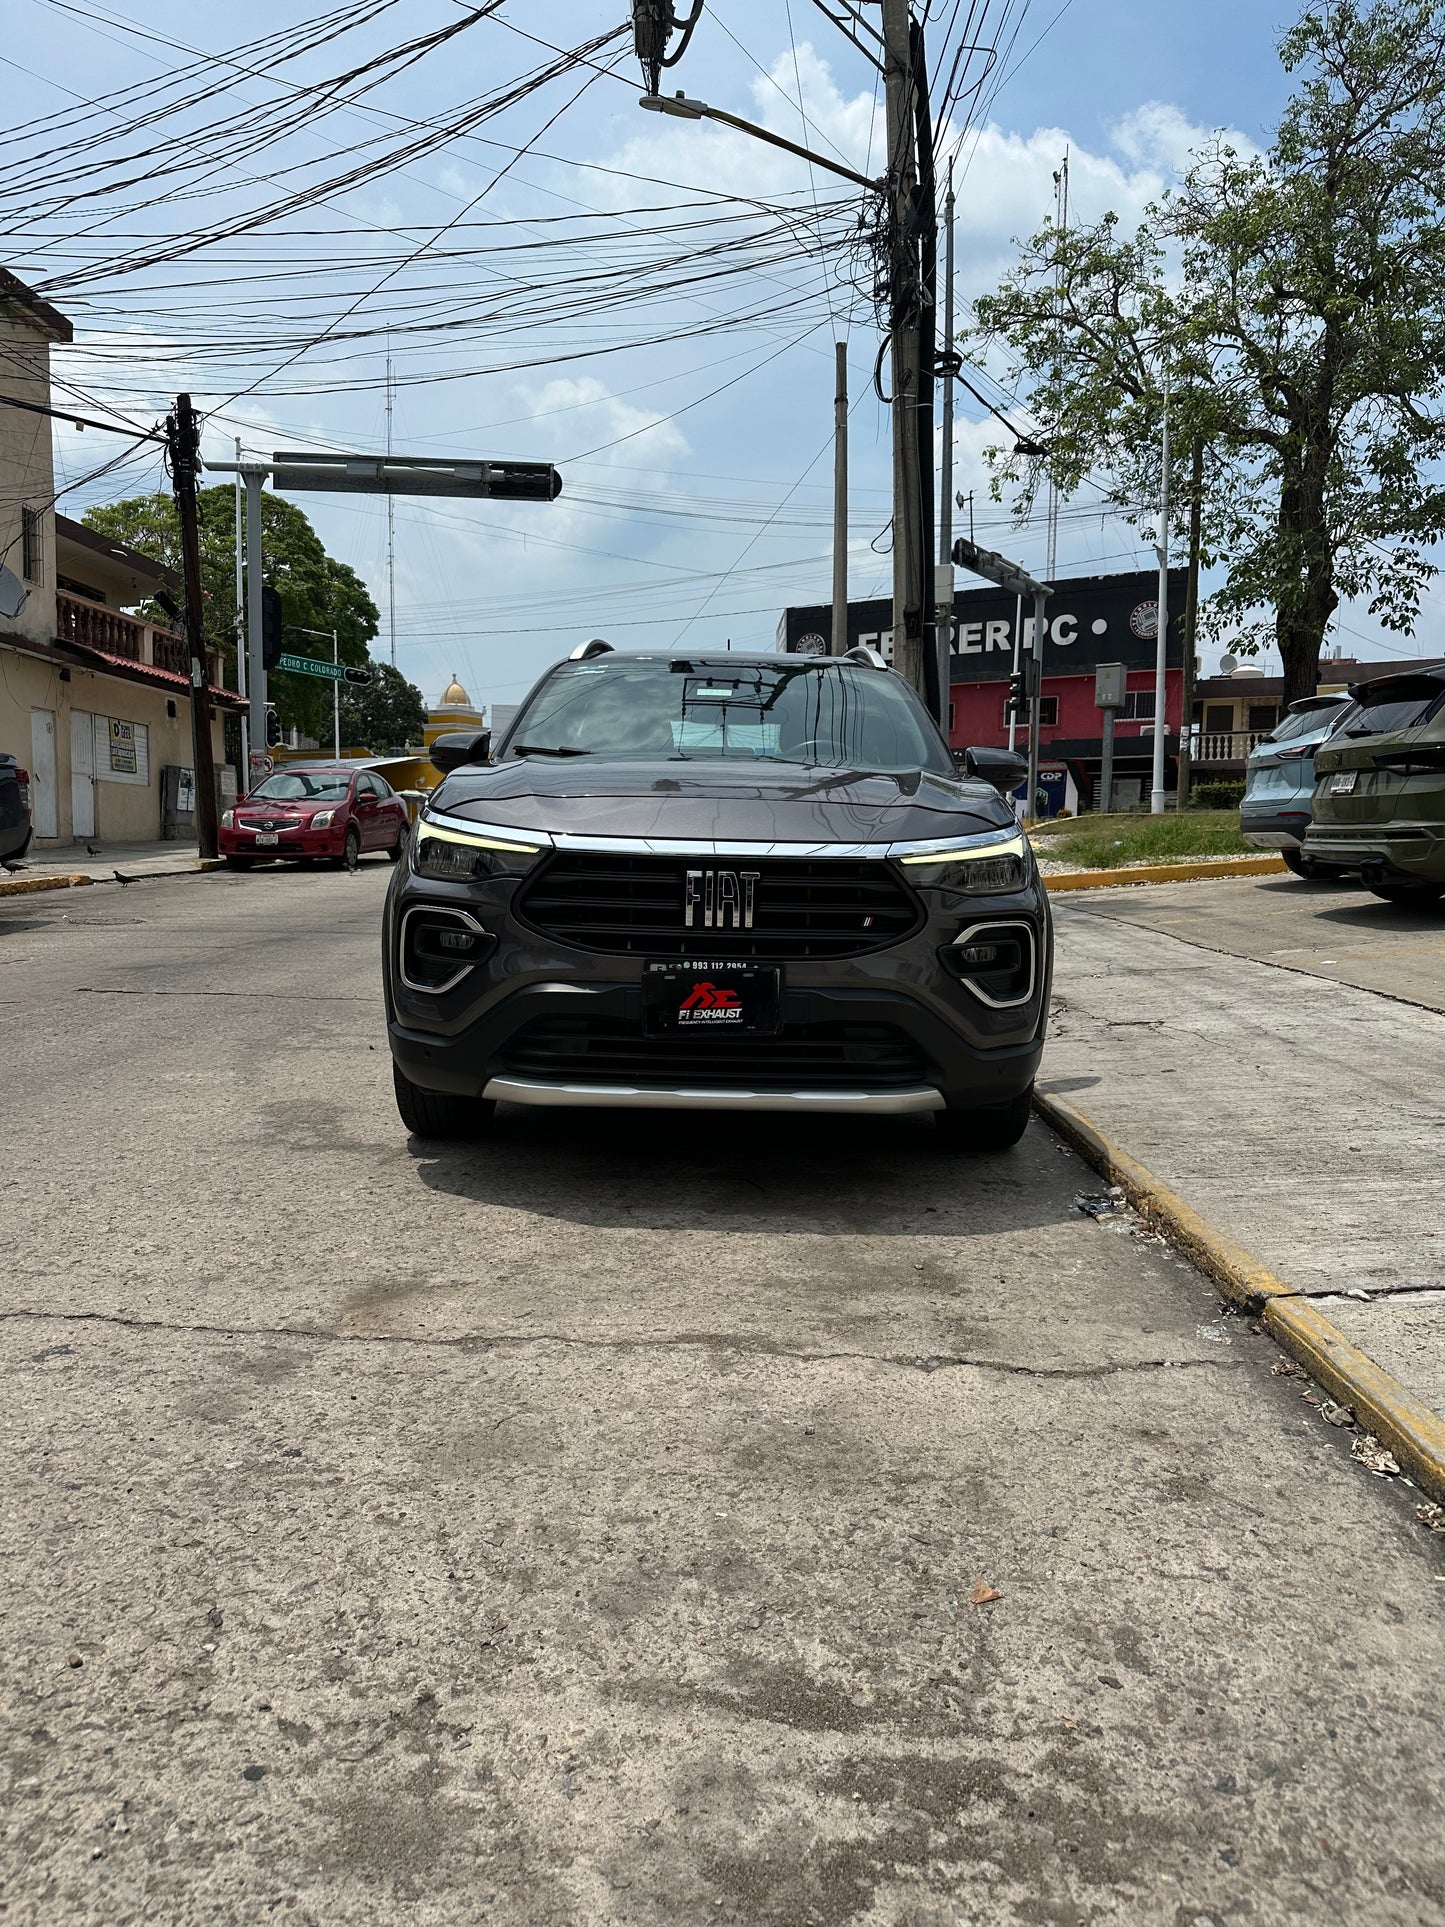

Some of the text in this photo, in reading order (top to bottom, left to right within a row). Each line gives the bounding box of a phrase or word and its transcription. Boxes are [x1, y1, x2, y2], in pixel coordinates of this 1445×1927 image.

[858, 614, 1078, 662] FEER PC
[279, 656, 301, 669] PEDRO
[310, 663, 342, 677] COLORADO
[1040, 772, 1062, 780] CDP
[685, 870, 760, 928] FIAT
[692, 961, 708, 970] 993
[711, 962, 724, 970] 112
[693, 1008, 743, 1019] EXHAUST
